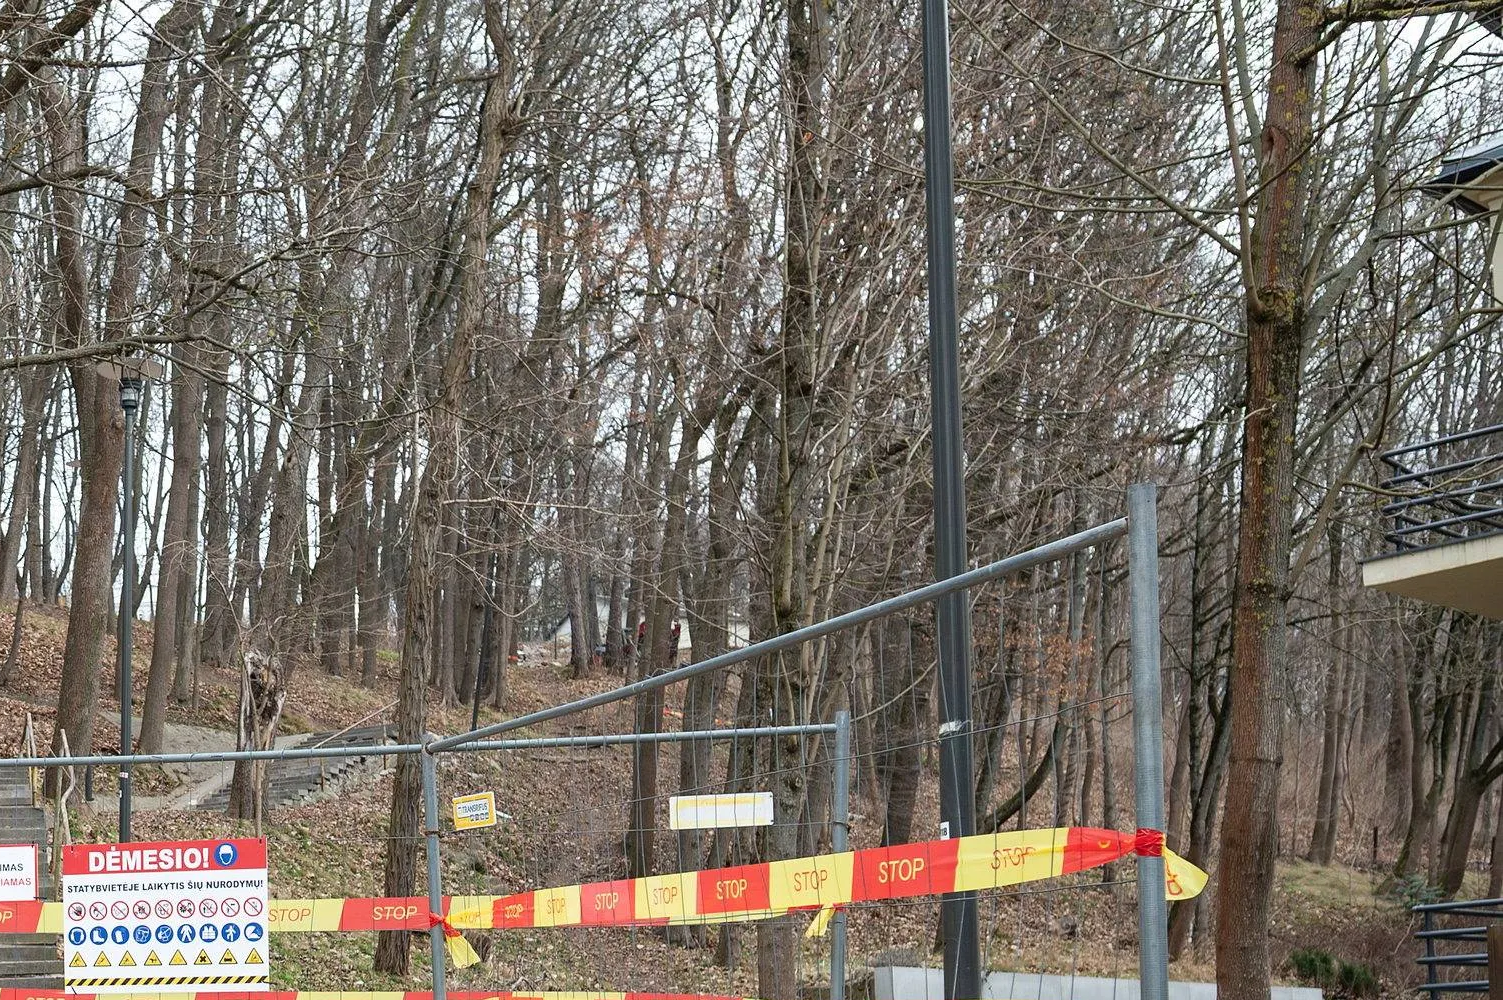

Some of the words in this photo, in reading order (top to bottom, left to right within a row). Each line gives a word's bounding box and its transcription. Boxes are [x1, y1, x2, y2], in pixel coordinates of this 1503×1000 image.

[88, 846, 210, 872] DĖMESIO!
[67, 882, 140, 893] STATYBVIETĖJE
[142, 882, 185, 892] LAIKYTIS
[187, 880, 203, 891] ŠIŲ
[205, 880, 263, 889] NURODYMŲ!
[546, 897, 566, 913] STOP
[595, 893, 619, 910] STOP
[653, 886, 678, 904] STOP
[716, 879, 747, 900] STOP
[794, 868, 828, 892] STOP
[878, 858, 925, 883] STOP
[991, 847, 1036, 869] STOP
[268, 909, 311, 922] STOP
[372, 906, 418, 920] STOP
